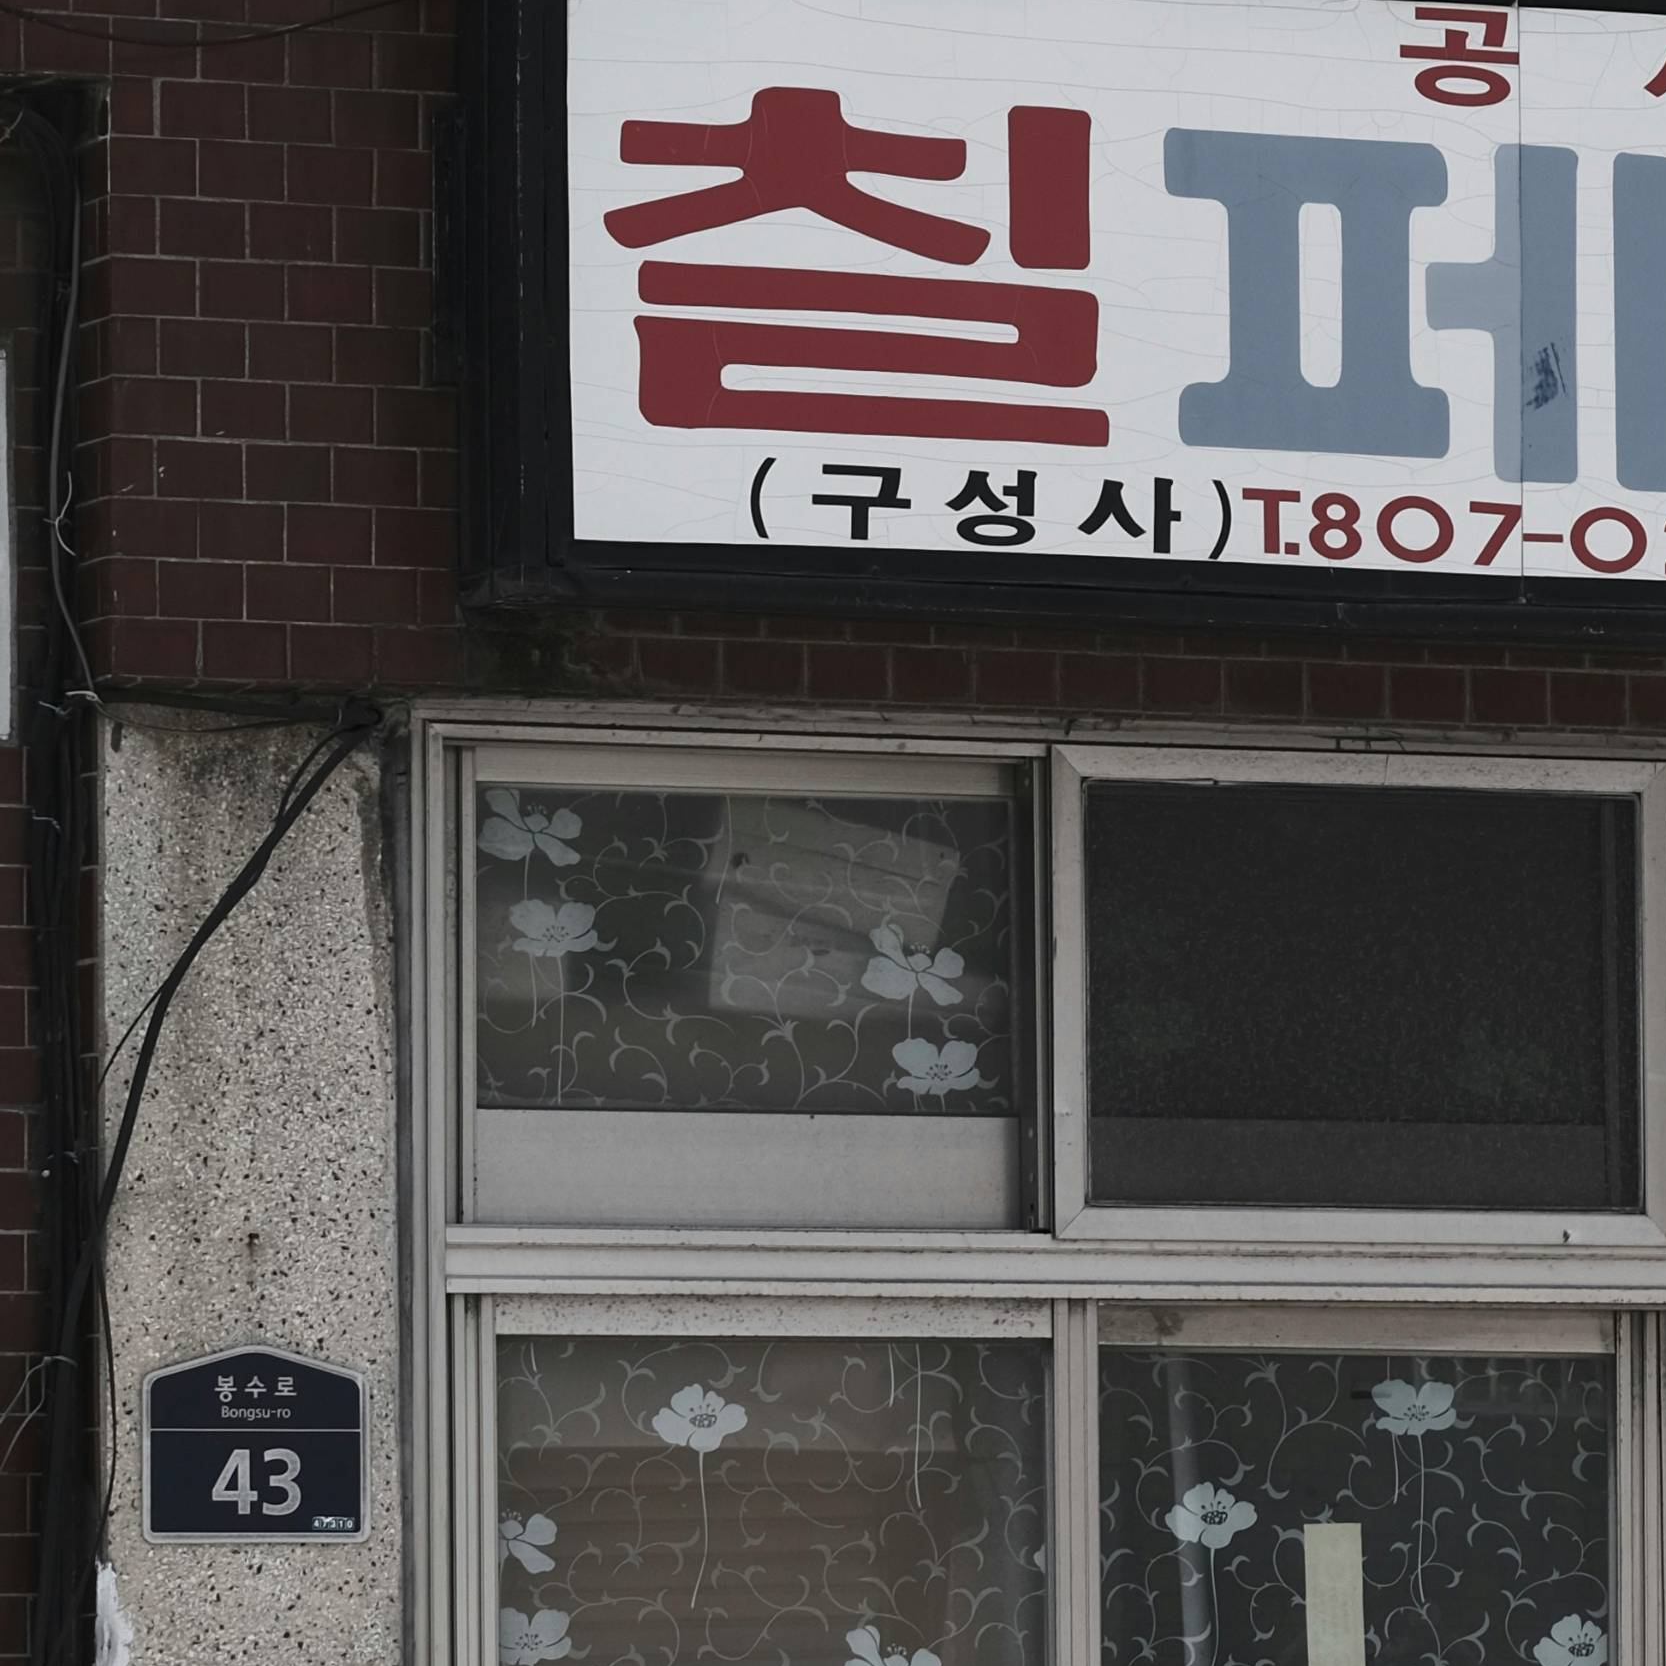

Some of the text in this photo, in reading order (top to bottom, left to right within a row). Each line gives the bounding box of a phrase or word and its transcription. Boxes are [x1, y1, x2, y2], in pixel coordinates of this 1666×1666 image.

[750, 458, 1231, 560] (구성사)
[214, 1375, 297, 1402] 봉수로
[221, 1405, 291, 1421] Bongsu-ro
[212, 1448, 301, 1516] 43
